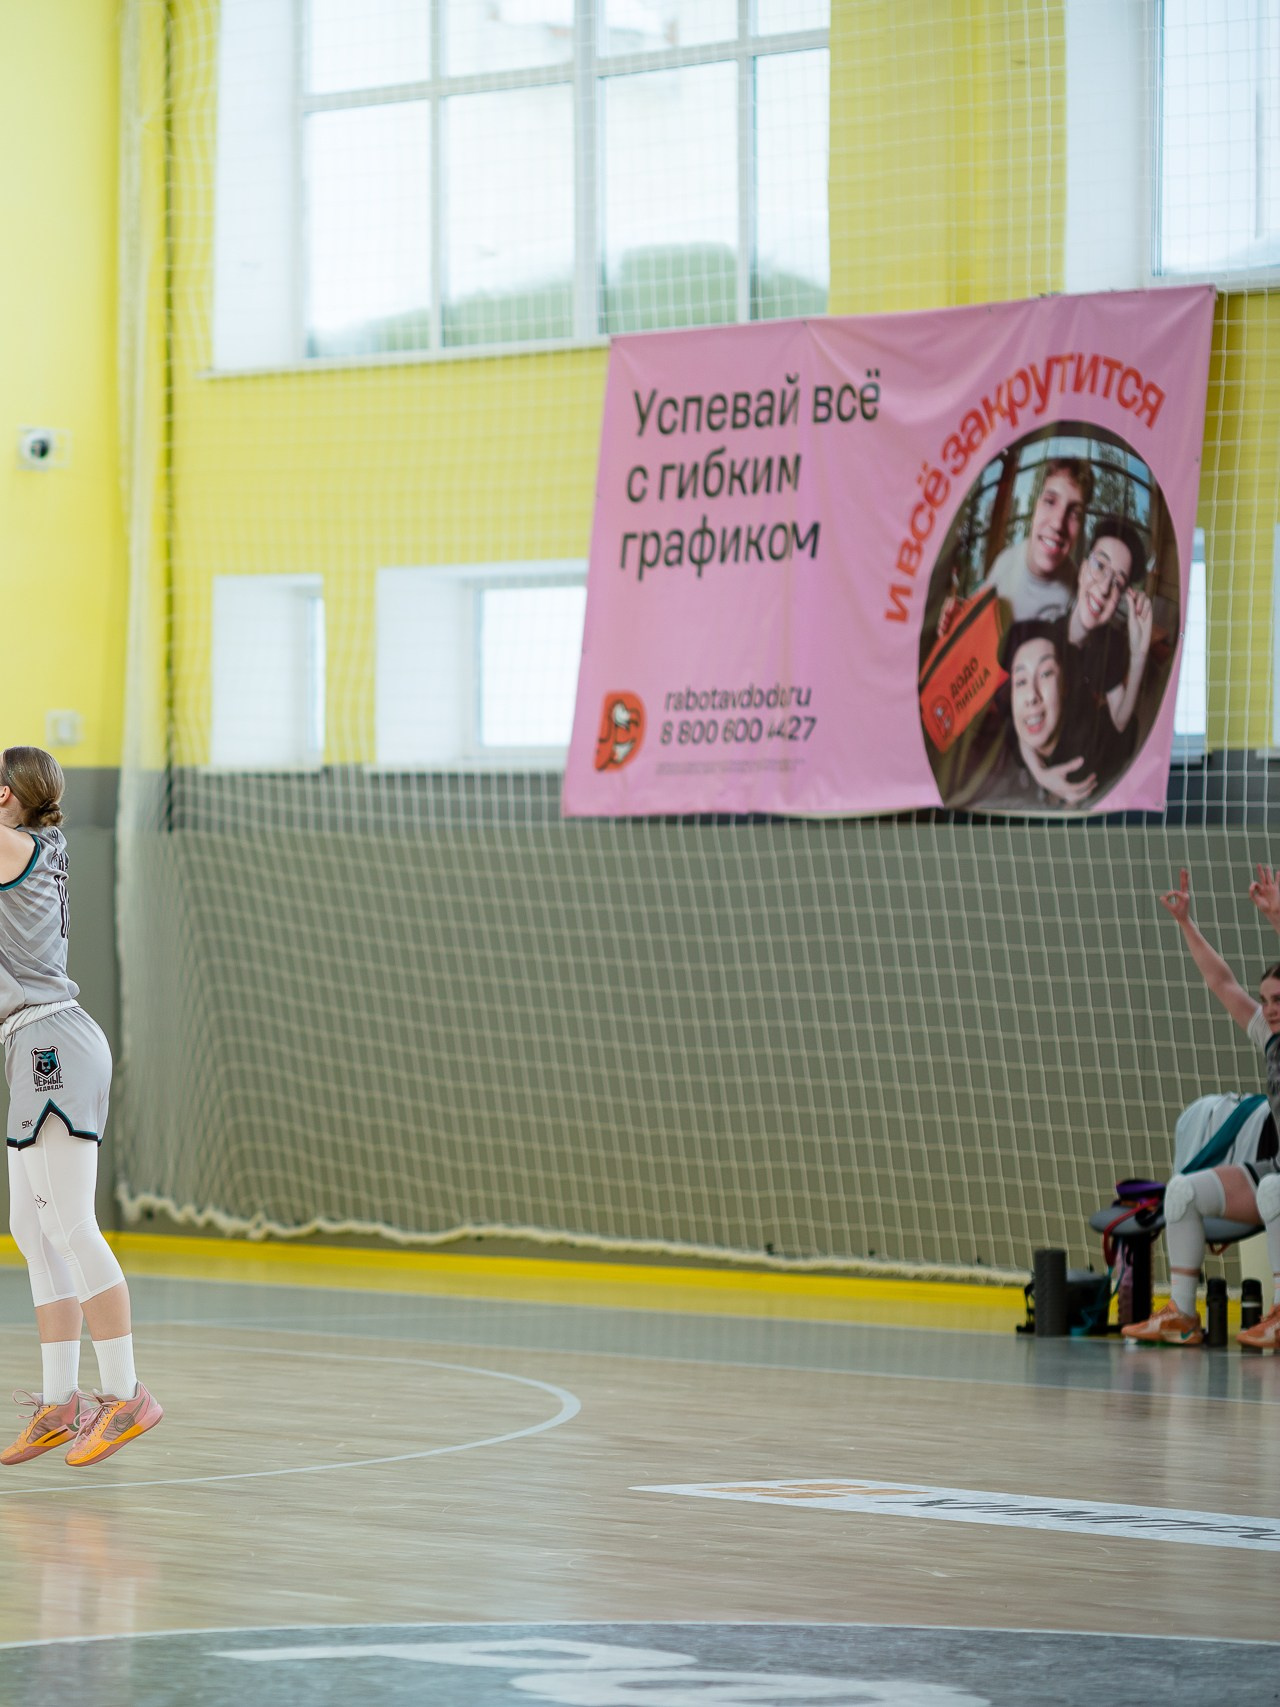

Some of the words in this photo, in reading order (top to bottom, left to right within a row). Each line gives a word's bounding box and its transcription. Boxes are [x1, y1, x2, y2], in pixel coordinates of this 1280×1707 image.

[634, 372, 800, 437] Успевай
[812, 368, 881, 424] всё
[941, 352, 1166, 478] закрутится
[627, 465, 648, 503] с
[658, 445, 802, 501] гибким
[620, 513, 821, 582] графиком
[896, 460, 952, 577] всё
[884, 582, 914, 623] и
[948, 656, 979, 699] ДОДО
[660, 721, 674, 746] 8
[677, 719, 719, 746] 800
[723, 718, 763, 744] 600
